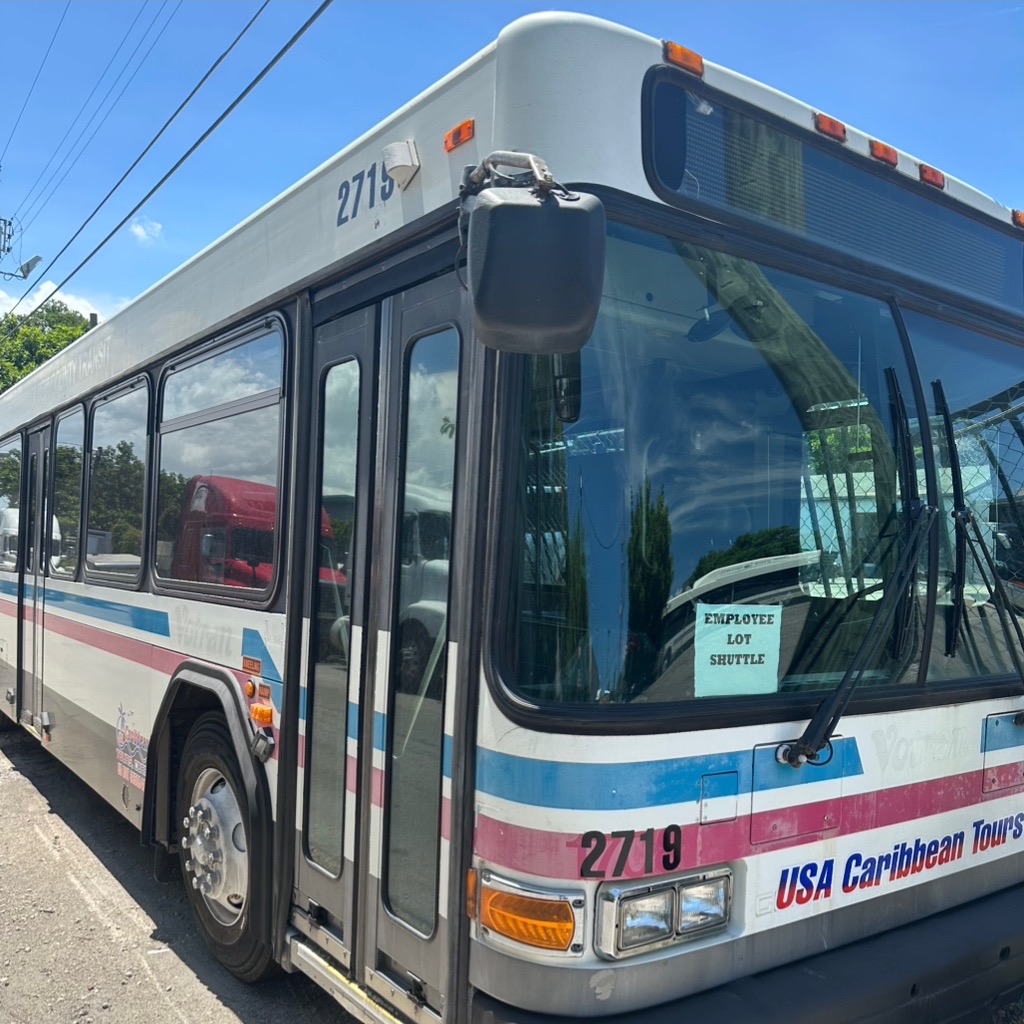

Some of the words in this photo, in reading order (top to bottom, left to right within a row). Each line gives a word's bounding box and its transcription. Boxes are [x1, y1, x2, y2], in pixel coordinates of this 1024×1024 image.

[704, 613, 774, 625] EMPLOYEE
[727, 634, 752, 645] LOT
[710, 654, 765, 666] SHUTTLE
[580, 824, 681, 877] 2719
[776, 858, 835, 910] USA
[841, 830, 965, 893] Caribbean
[972, 812, 1024, 855] Tours
